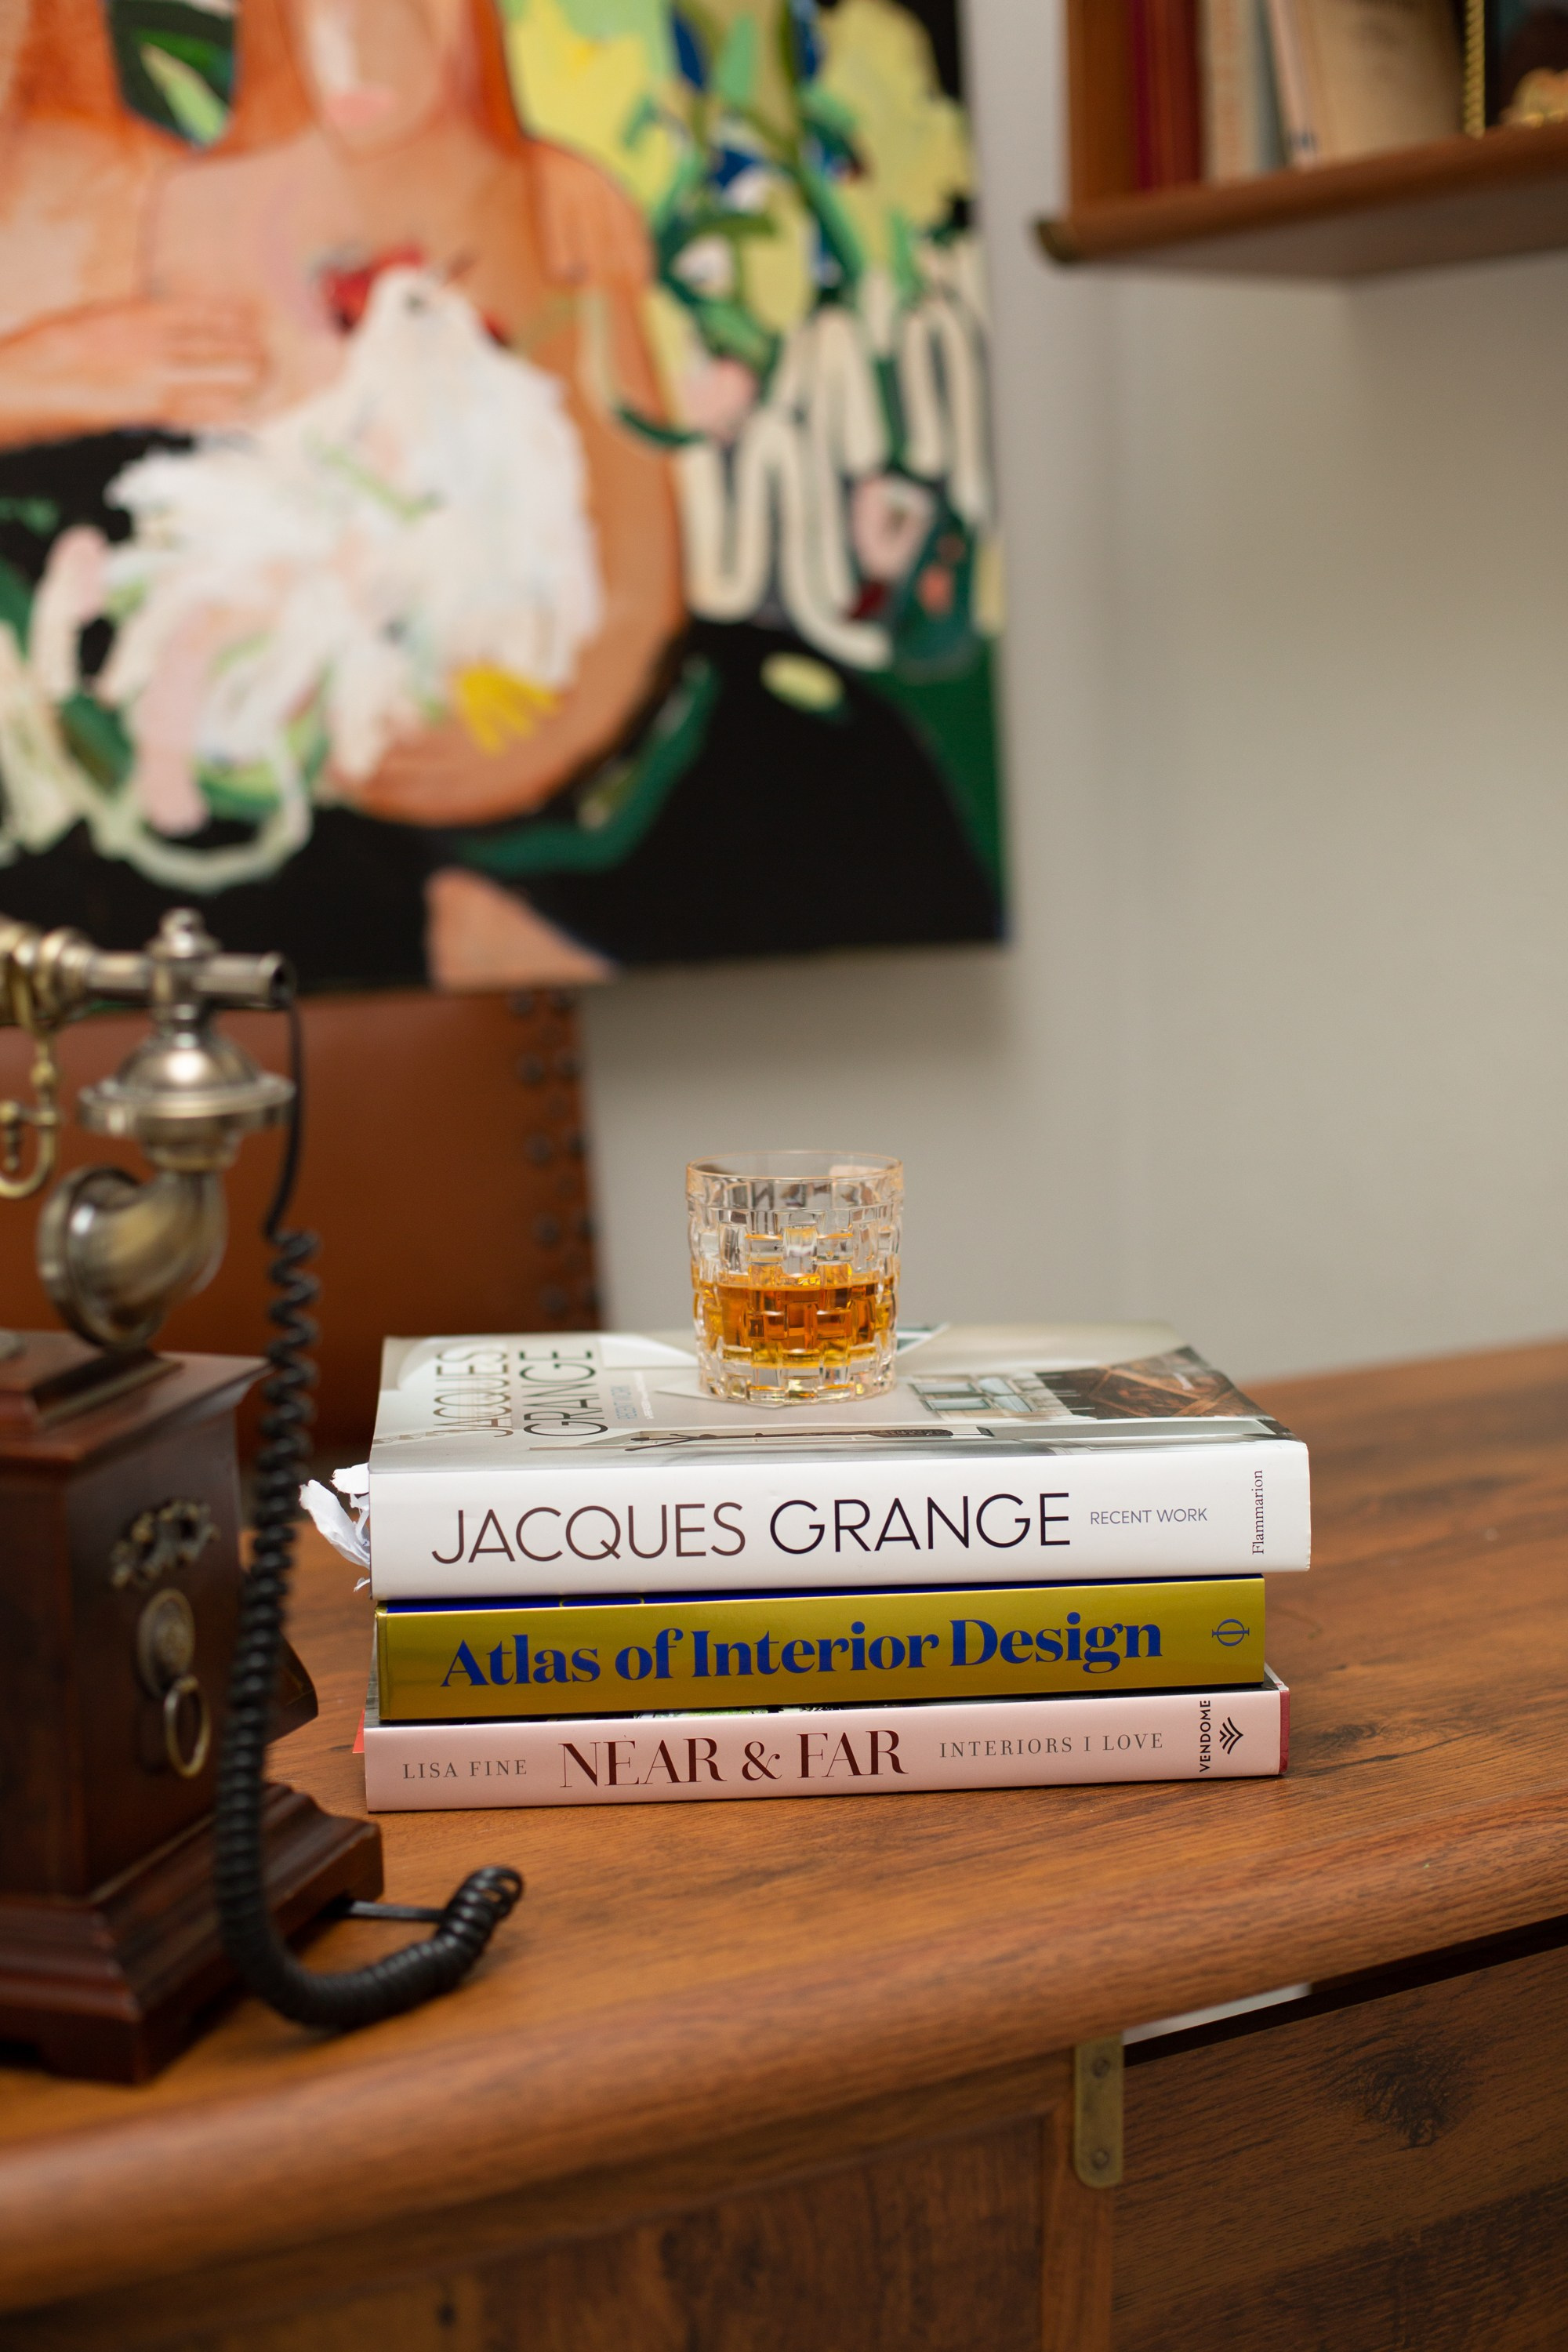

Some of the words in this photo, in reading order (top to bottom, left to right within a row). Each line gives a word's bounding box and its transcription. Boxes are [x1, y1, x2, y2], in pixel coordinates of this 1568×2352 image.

[433, 1349, 514, 1438] JACQUES
[518, 1349, 609, 1437] GRANGE
[431, 1501, 746, 1565] JACQUES
[769, 1492, 1071, 1555] GRANGE
[1090, 1509, 1152, 1525] RECENT
[1156, 1508, 1208, 1523] WORK
[1251, 1469, 1265, 1555] Flammarion
[441, 1634, 601, 1687] Atlas
[615, 1628, 684, 1680] of
[691, 1621, 939, 1678] Interior
[949, 1611, 1163, 1674] Design
[402, 1762, 459, 1779] LISA
[469, 1759, 527, 1777] FINE
[557, 1737, 727, 1788] NEAR
[741, 1741, 782, 1781] &
[797, 1730, 909, 1779] FAR
[939, 1737, 1073, 1758] INTERIORS
[1083, 1736, 1091, 1751] I
[1102, 1733, 1163, 1751] LOVE
[1200, 1700, 1211, 1773] VENDOME
